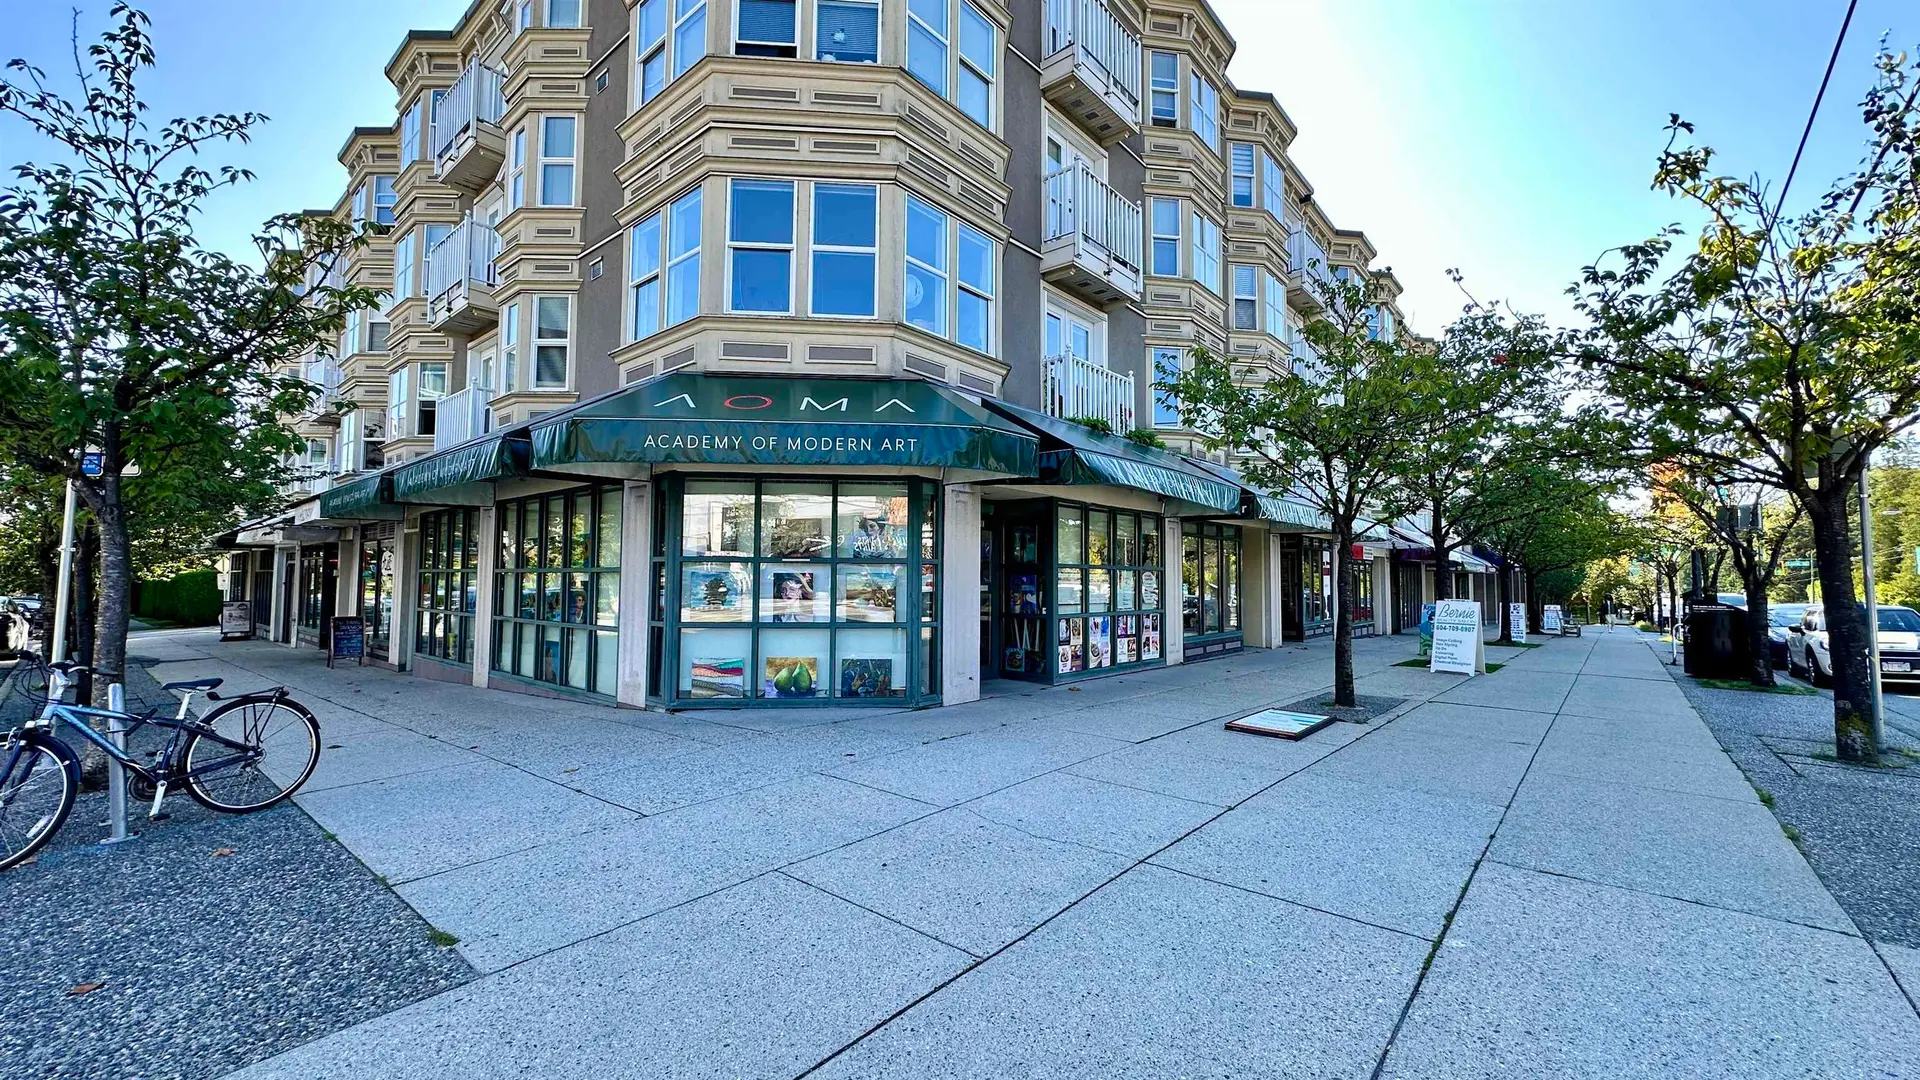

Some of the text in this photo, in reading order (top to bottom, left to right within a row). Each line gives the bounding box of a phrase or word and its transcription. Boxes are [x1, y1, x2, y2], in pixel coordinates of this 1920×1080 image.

[643, 434, 918, 452] ACADEMY OF MODERN ART
[1439, 604, 1475, 619] Bernie
